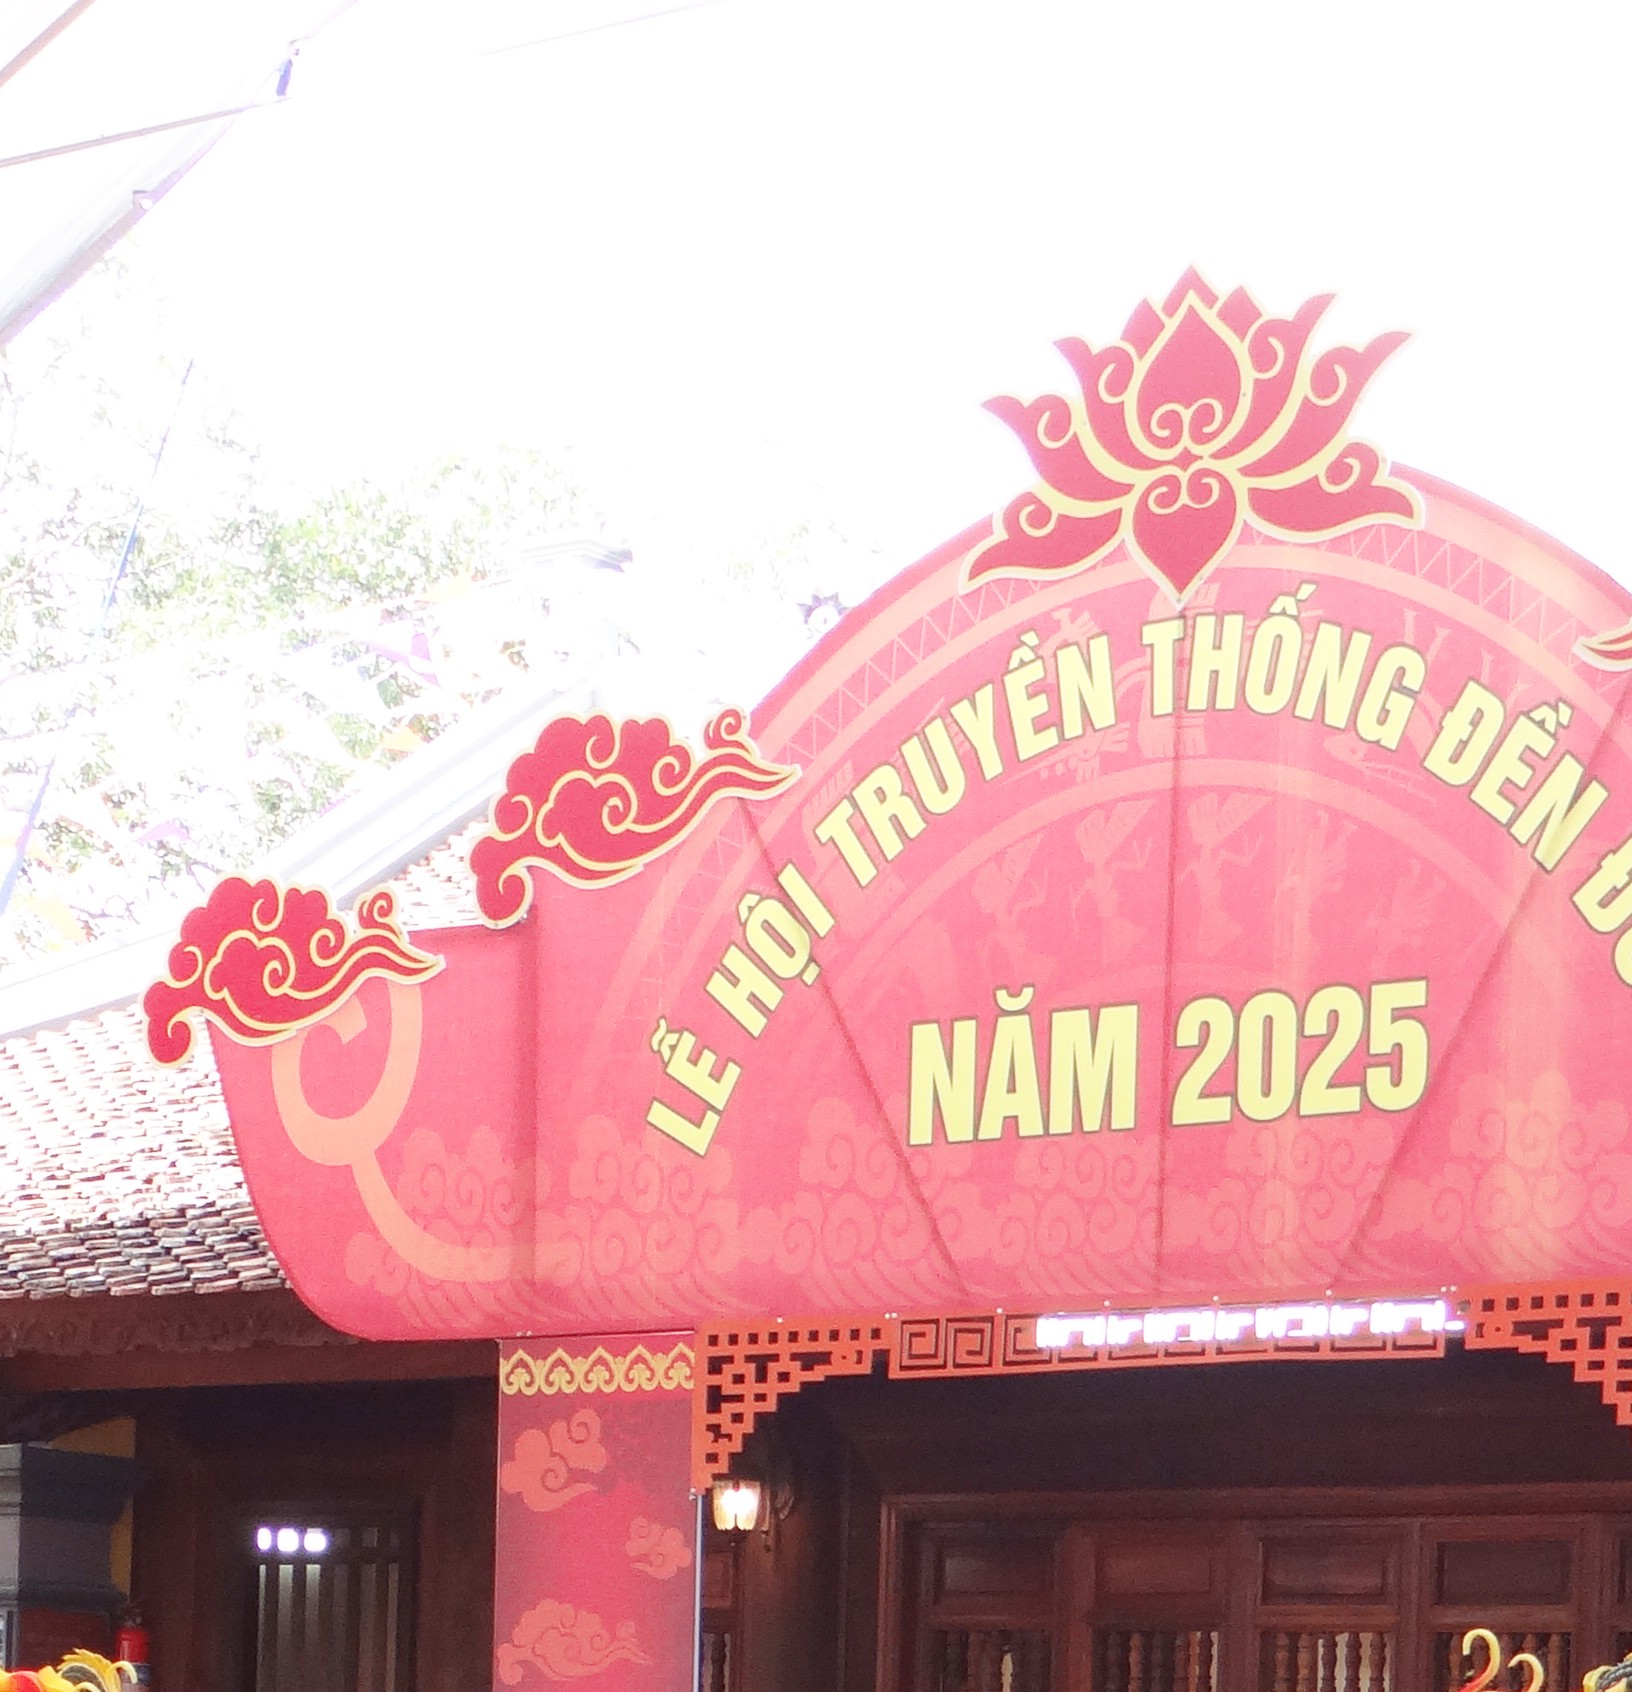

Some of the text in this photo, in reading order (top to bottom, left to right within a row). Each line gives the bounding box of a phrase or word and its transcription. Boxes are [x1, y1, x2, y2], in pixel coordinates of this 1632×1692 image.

[645, 1015, 743, 1157] LỄ
[705, 860, 837, 1035] HỘI
[814, 631, 1118, 890] TRUYỀN
[1140, 580, 1429, 751] THỐNG
[1421, 677, 1612, 875] ĐỀN
[906, 979, 1431, 1149] NĂM 2025
